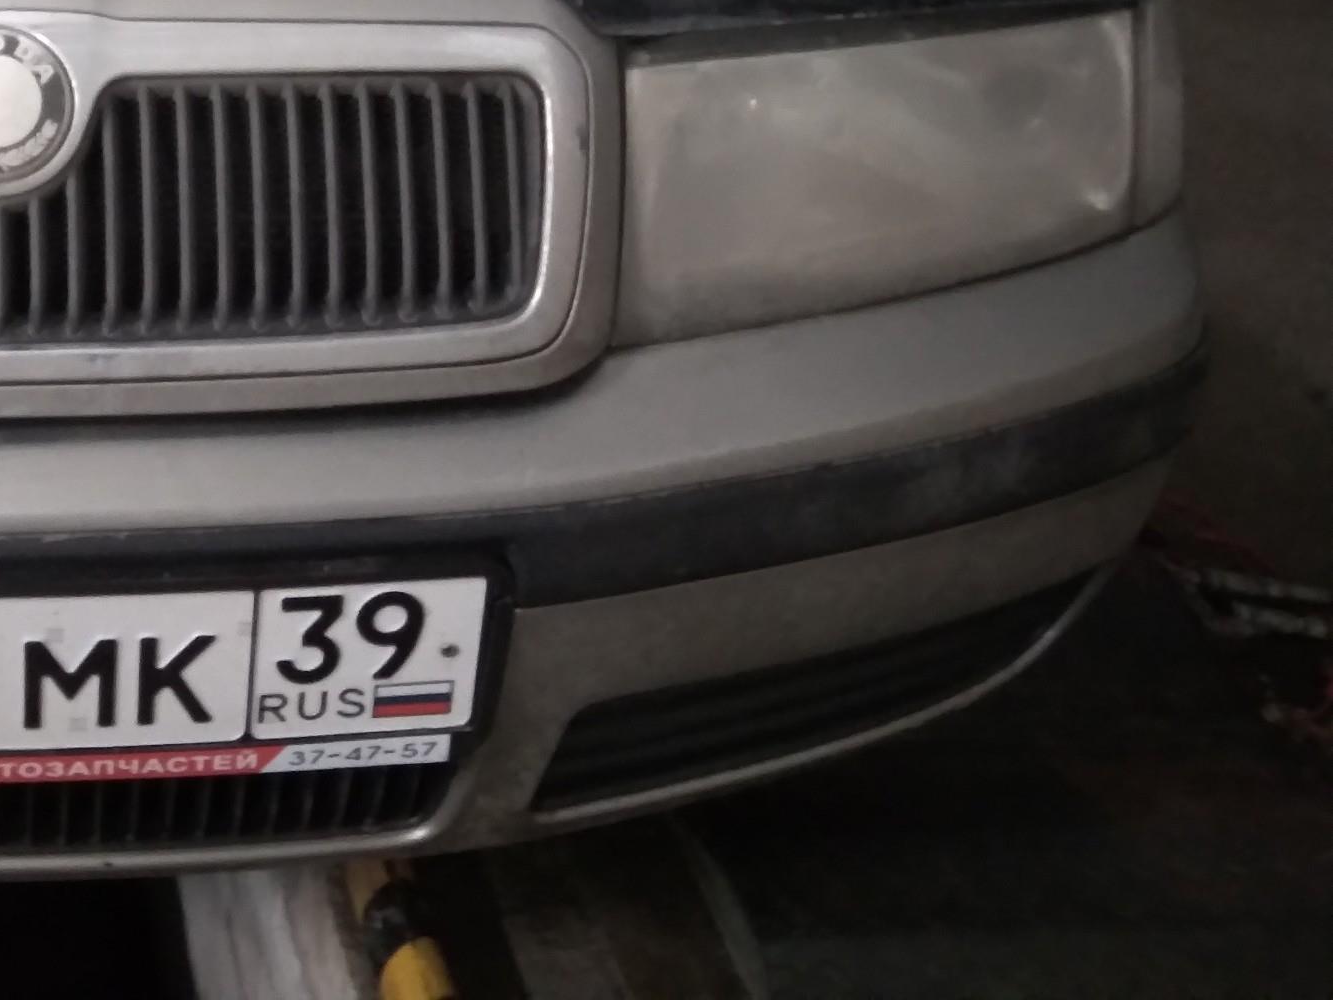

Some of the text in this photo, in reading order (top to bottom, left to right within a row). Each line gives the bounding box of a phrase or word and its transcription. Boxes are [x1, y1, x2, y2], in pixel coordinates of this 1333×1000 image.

[277, 590, 424, 684] 39
[258, 686, 366, 724] RUS
[288, 740, 439, 768] 37-47-57
